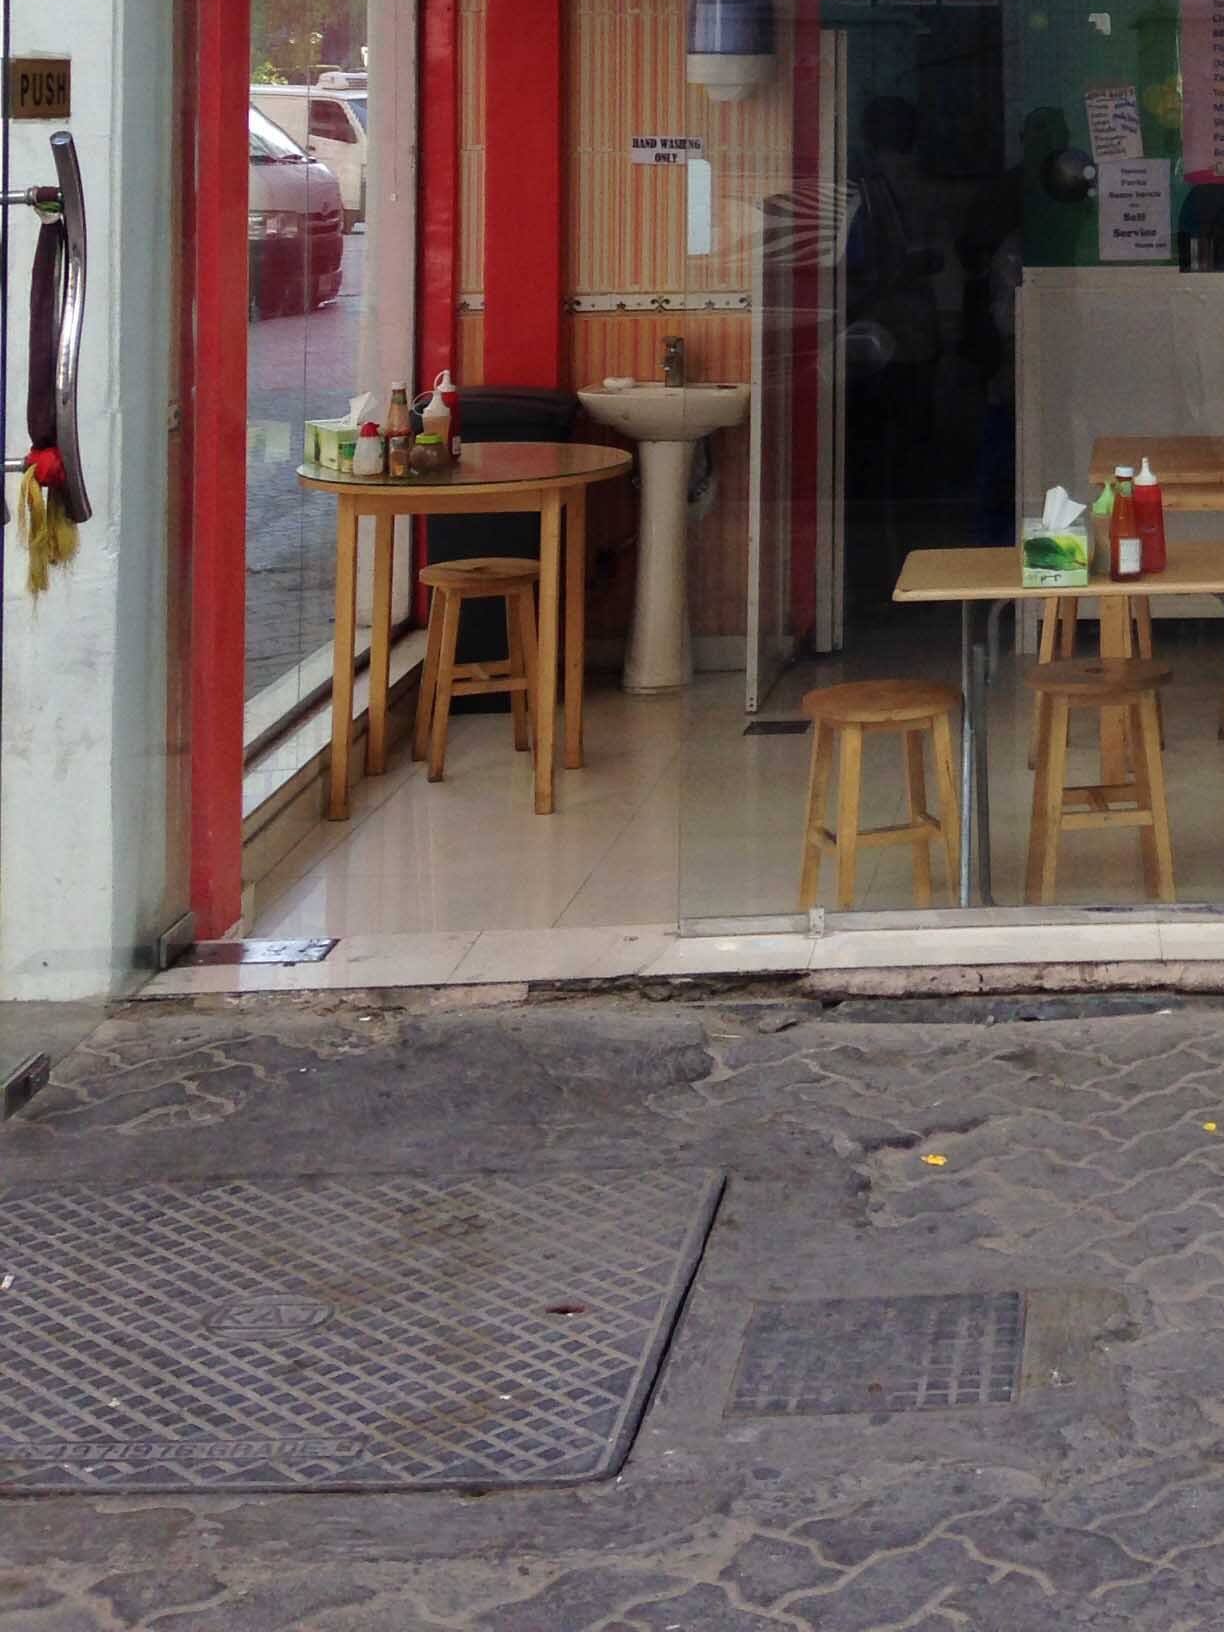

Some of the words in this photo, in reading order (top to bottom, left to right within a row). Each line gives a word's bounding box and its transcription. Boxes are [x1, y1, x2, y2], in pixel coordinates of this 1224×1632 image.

[20, 72, 67, 107] PUSH
[632, 138, 657, 149] HAND
[654, 152, 677, 163] ONLY
